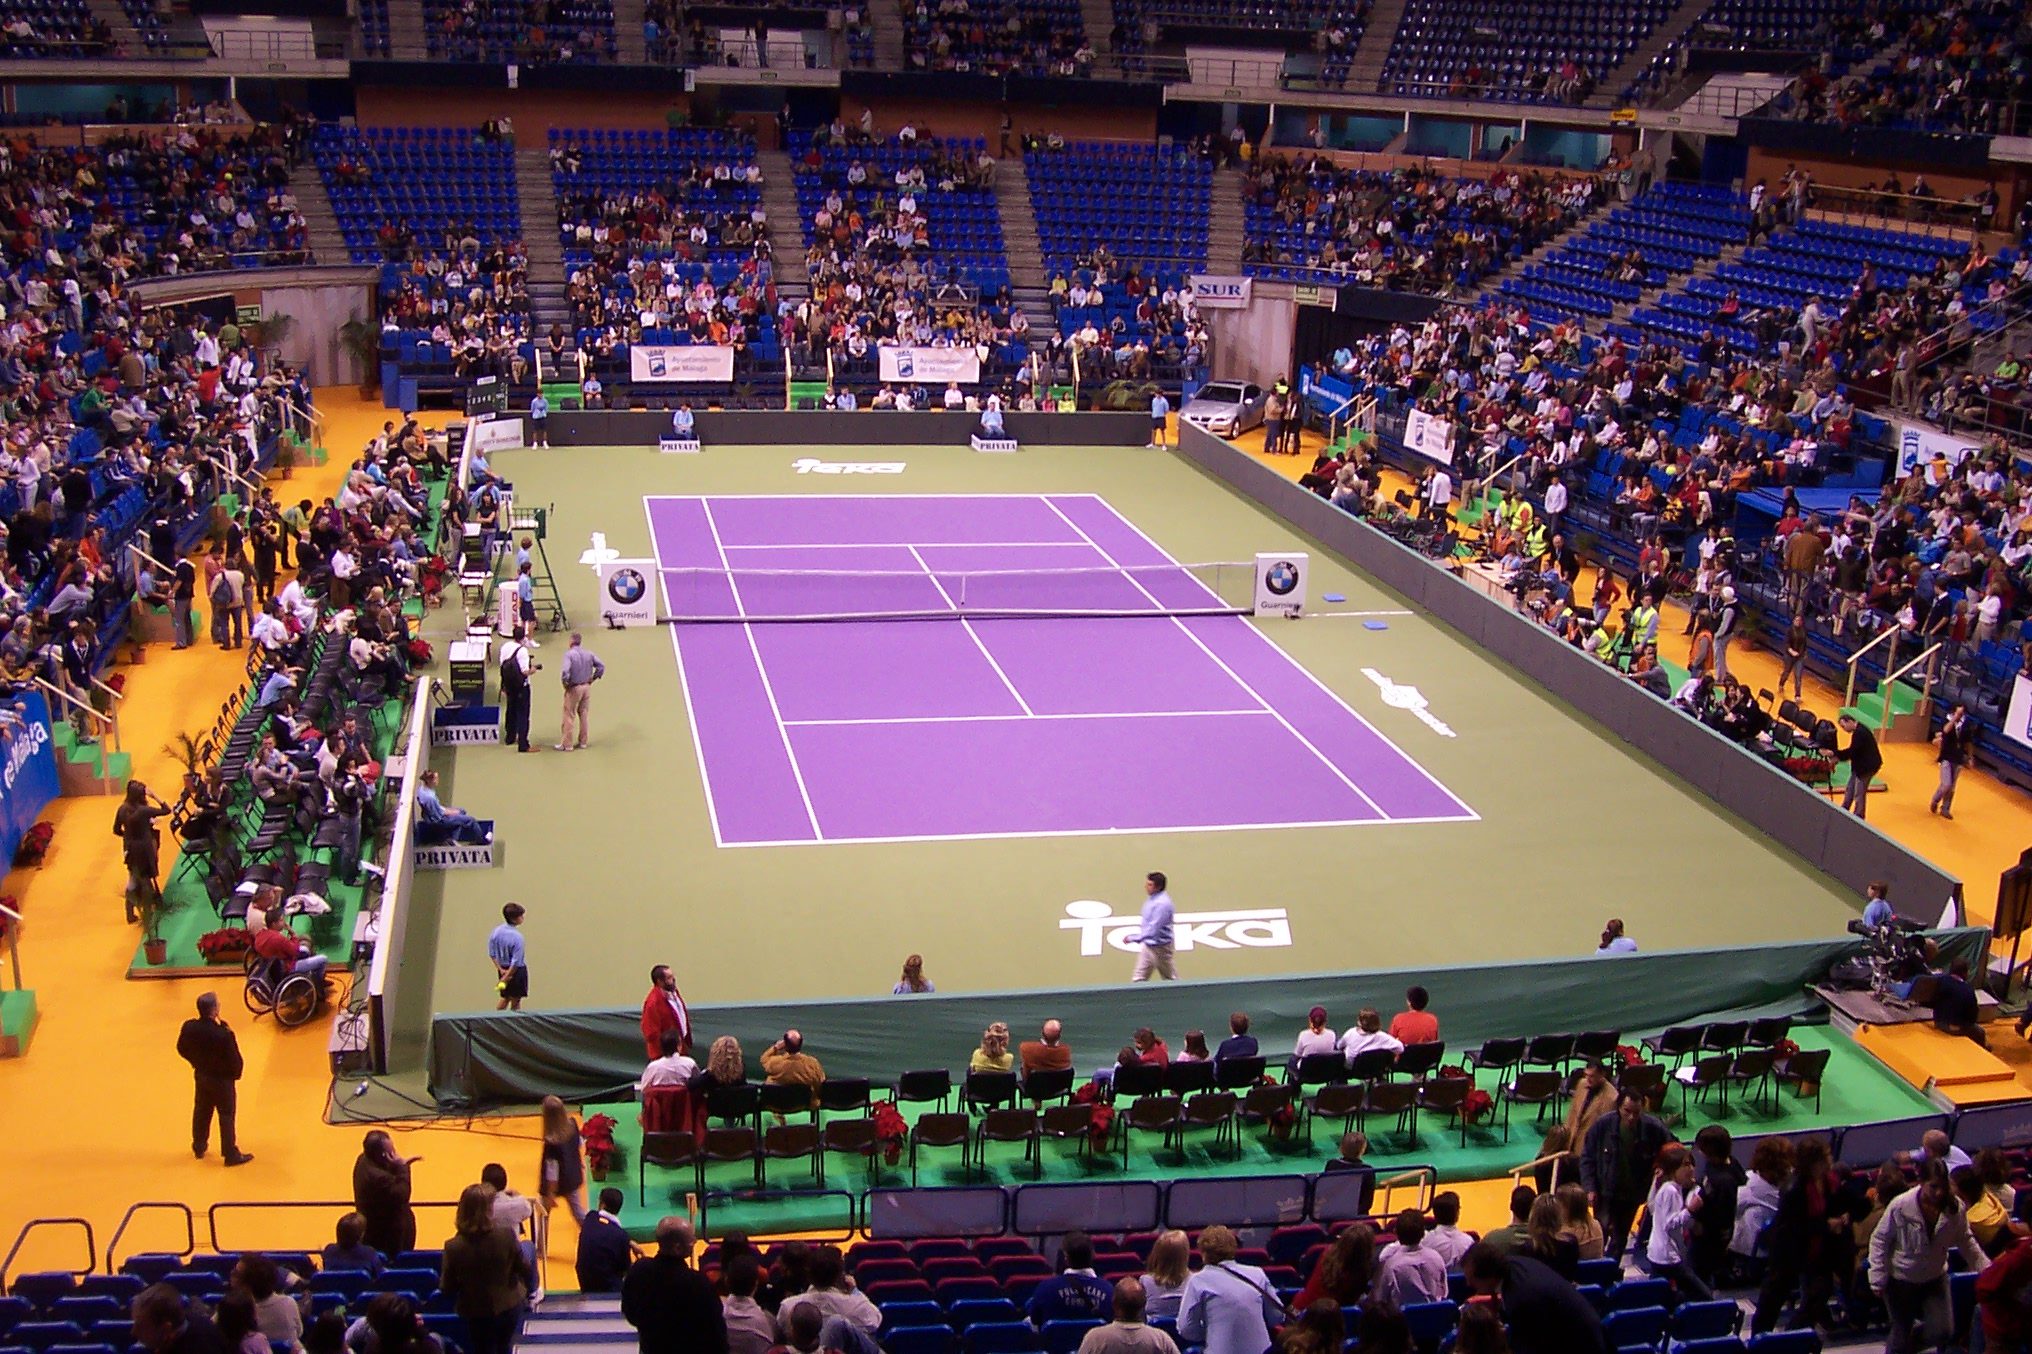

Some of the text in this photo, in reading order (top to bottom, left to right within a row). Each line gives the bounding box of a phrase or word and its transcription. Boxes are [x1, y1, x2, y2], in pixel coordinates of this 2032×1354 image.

[1197, 284, 1241, 296] SUR
[980, 442, 1016, 450] PRIVATA
[1260, 600, 1302, 610] Guarnie
[434, 729, 498, 741] PRIVATA
[415, 850, 491, 865] PRIVATA
